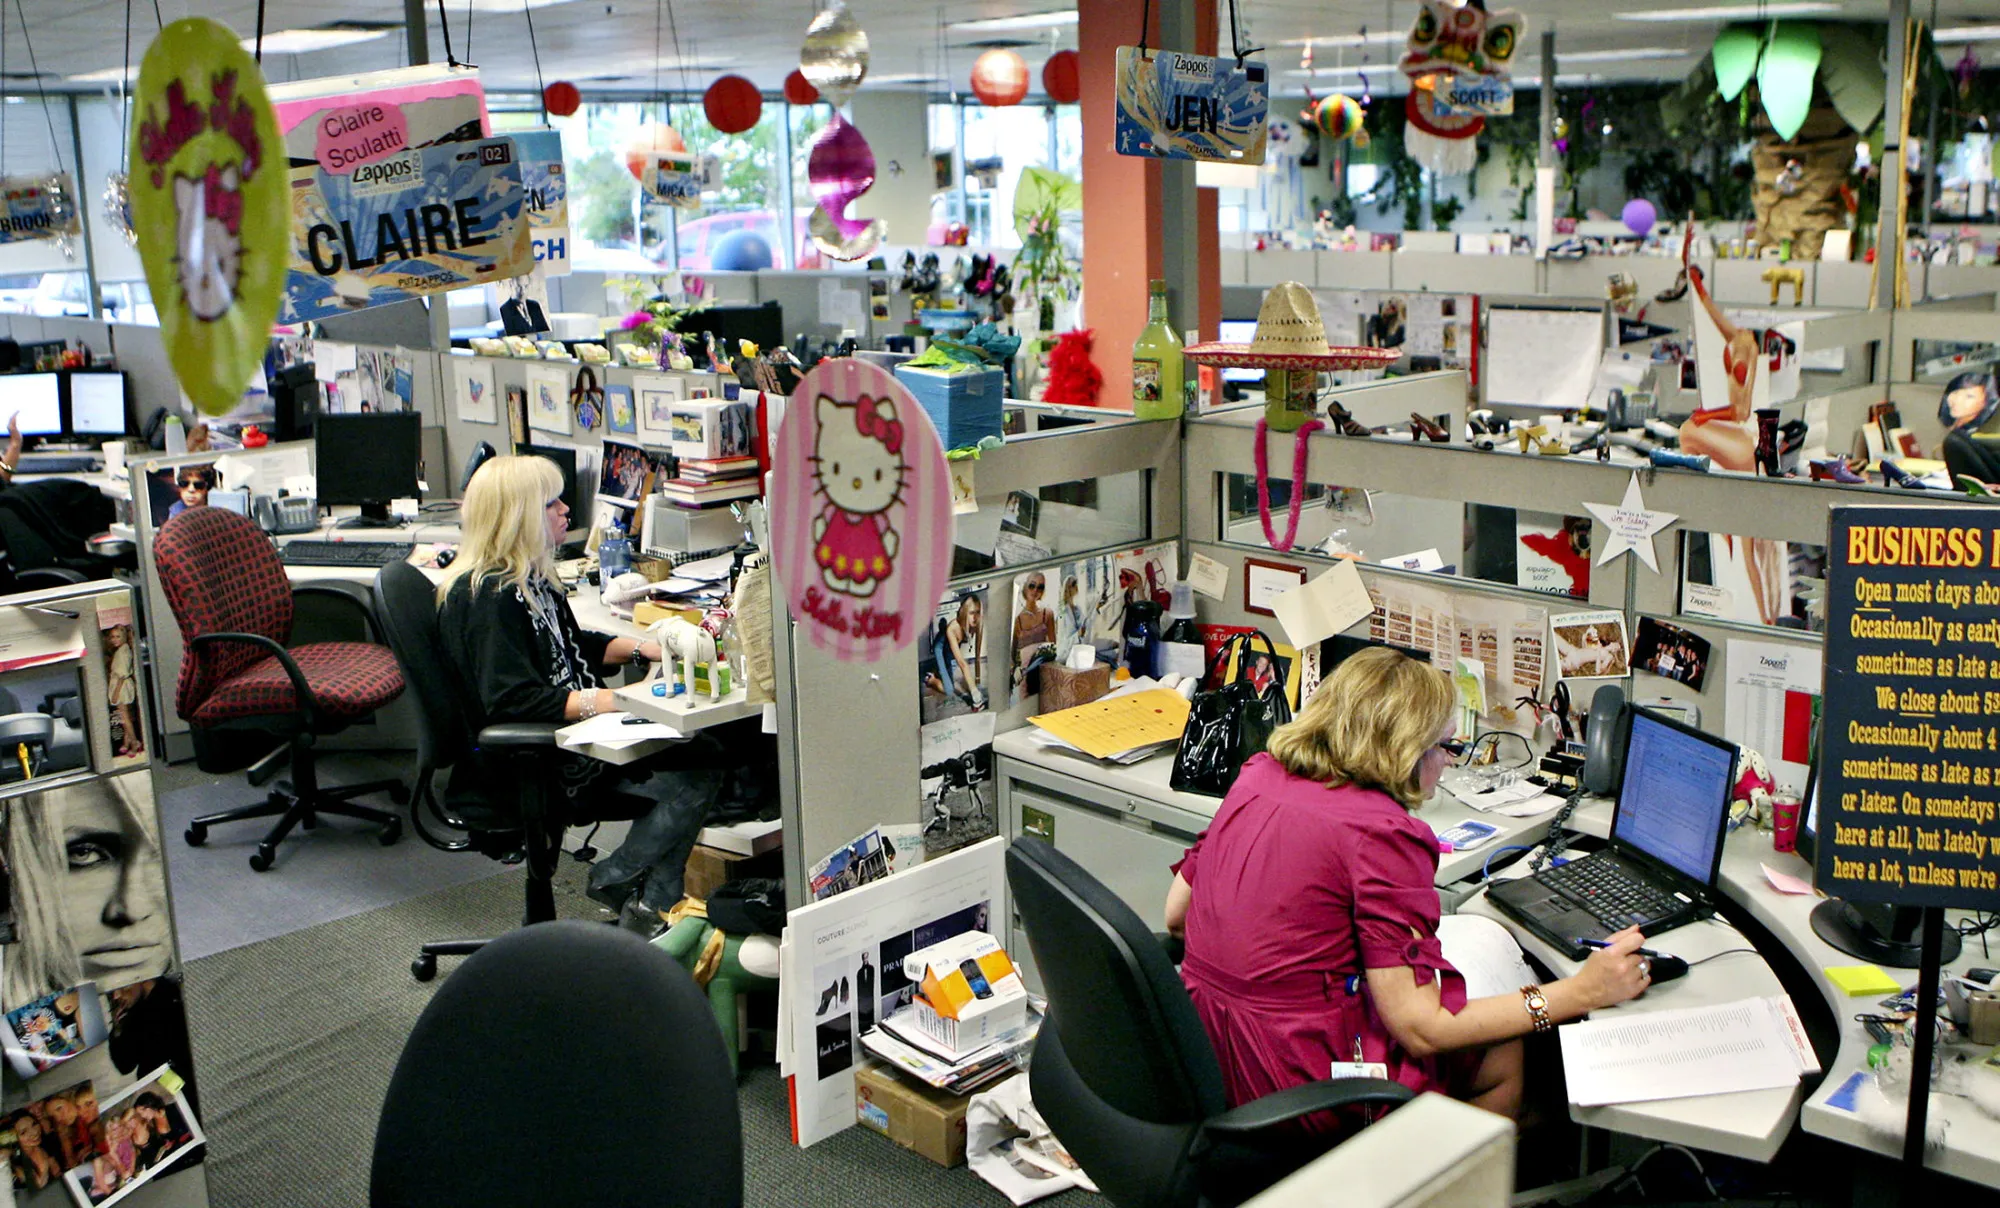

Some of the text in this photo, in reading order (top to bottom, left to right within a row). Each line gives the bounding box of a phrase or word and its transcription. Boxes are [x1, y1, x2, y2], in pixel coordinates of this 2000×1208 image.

[1174, 54, 1208, 73] Zappos
[1165, 94, 1218, 135] JEN
[1449, 90, 1495, 105] SCOTT
[324, 106, 385, 138] Claire
[327, 126, 404, 169] Sculatti
[484, 147, 502, 162] 02
[352, 159, 412, 185] Zappos
[307, 196, 487, 277] CLAIRE
[1847, 526, 1982, 568] BUSINESS
[1855, 577, 1892, 608] Open
[1895, 579, 1933, 604] most
[1935, 578, 1971, 611] days
[801, 585, 904, 643] Hello Kitty
[1850, 613, 1944, 647] Occasionally
[1946, 621, 1965, 642] as
[1856, 650, 1934, 677] sometimes
[1936, 656, 1954, 677] as
[1956, 653, 1987, 679] late
[1875, 686, 1897, 711] We
[1899, 687, 1936, 713] close
[1939, 688, 1981, 715] about
[1848, 719, 1997, 753] Occasionally about 4
[1842, 754, 1918, 782] sometimes
[1921, 763, 1938, 783] as
[1940, 759, 1971, 785] late
[1973, 766, 1991, 787] as
[1841, 792, 1858, 812] or
[1859, 788, 1898, 815] later.
[1902, 791, 1922, 816] On
[1925, 794, 1995, 826] somedays
[1834, 821, 1867, 847] here
[1869, 824, 1885, 848] at
[1887, 825, 1913, 855] all,
[1916, 825, 1942, 852] but
[1943, 827, 1988, 860] lately
[1832, 855, 1998, 890] here a lot, unless we're
